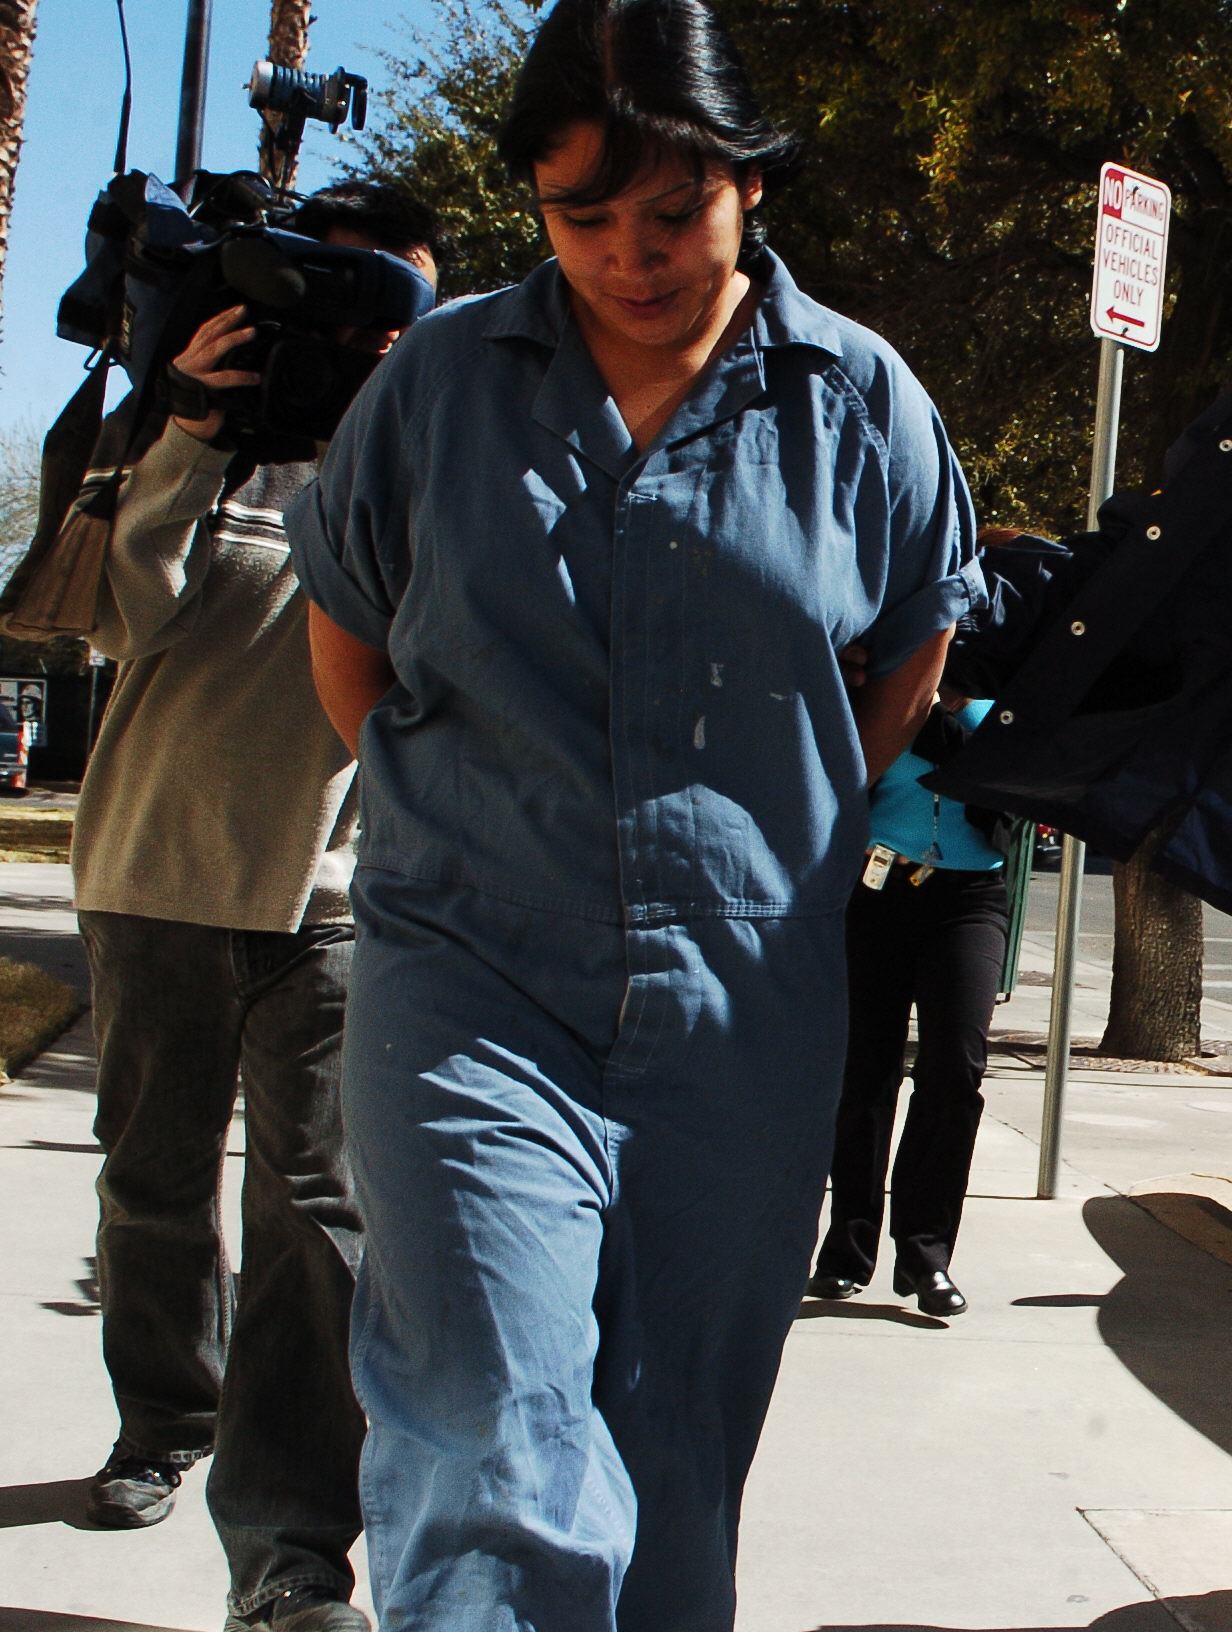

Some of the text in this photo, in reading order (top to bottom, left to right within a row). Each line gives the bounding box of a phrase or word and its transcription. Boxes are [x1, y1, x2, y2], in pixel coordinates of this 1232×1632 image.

[1104, 177, 1164, 221] NO PARKING
[1106, 223, 1158, 261] OFFICIAL
[1104, 248, 1158, 287] VEHICLES
[1114, 279, 1144, 307] ONLY
